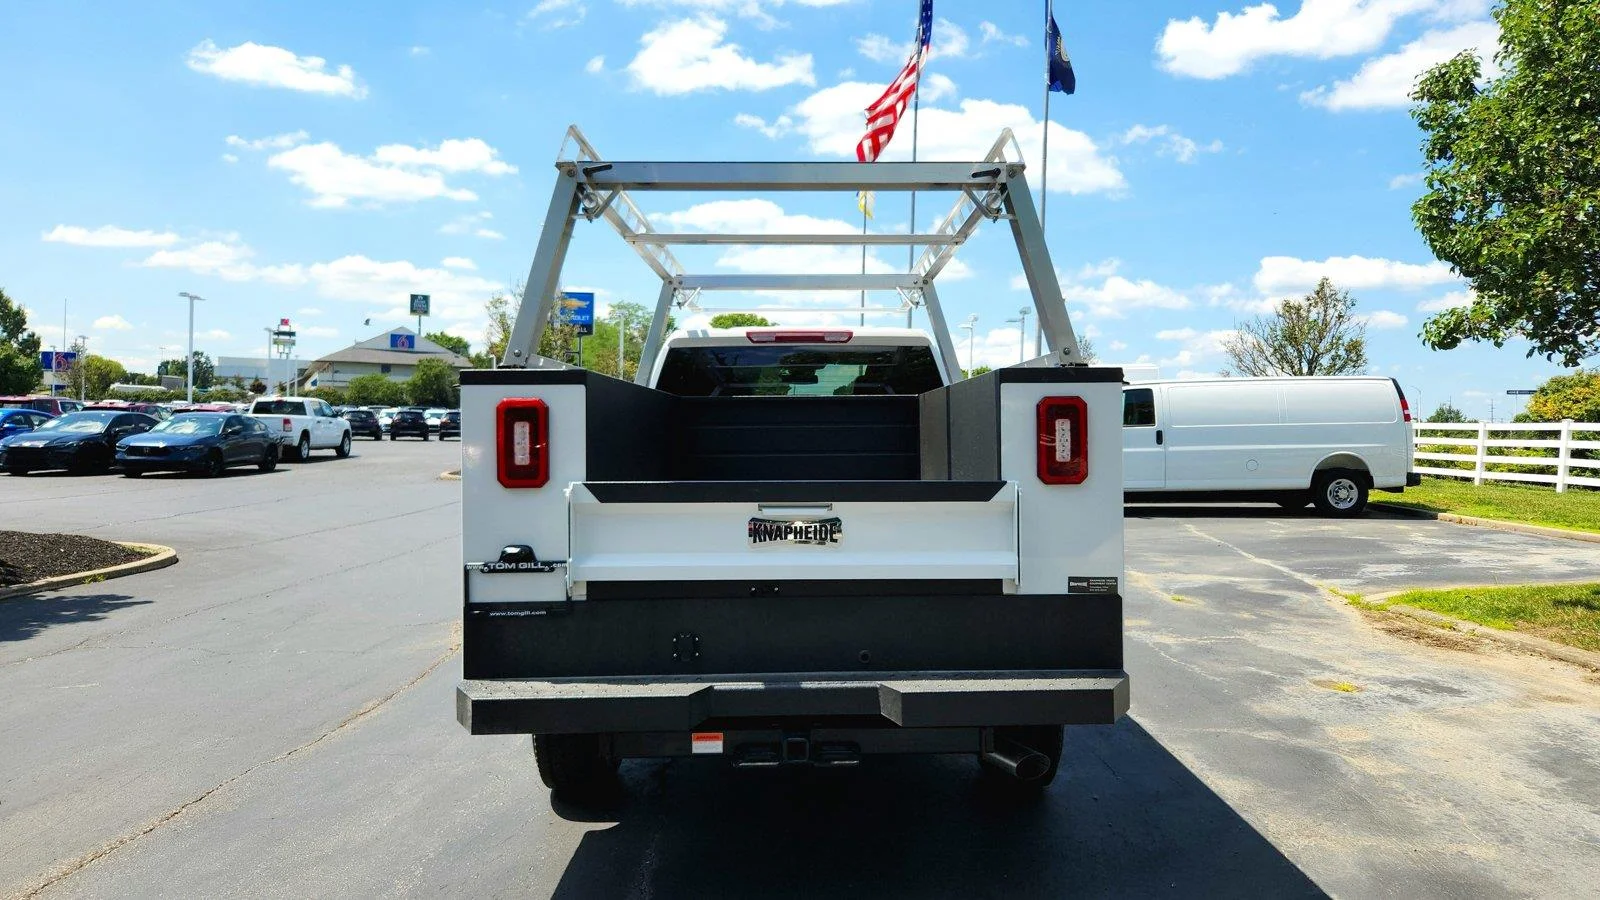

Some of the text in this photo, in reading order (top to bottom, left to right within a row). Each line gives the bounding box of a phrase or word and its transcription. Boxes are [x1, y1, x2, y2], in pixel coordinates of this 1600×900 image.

[397, 335, 409, 350] 6
[55, 353, 68, 371] 6
[751, 521, 839, 544] KNAPHEIDE
[488, 562, 519, 570] TOM
